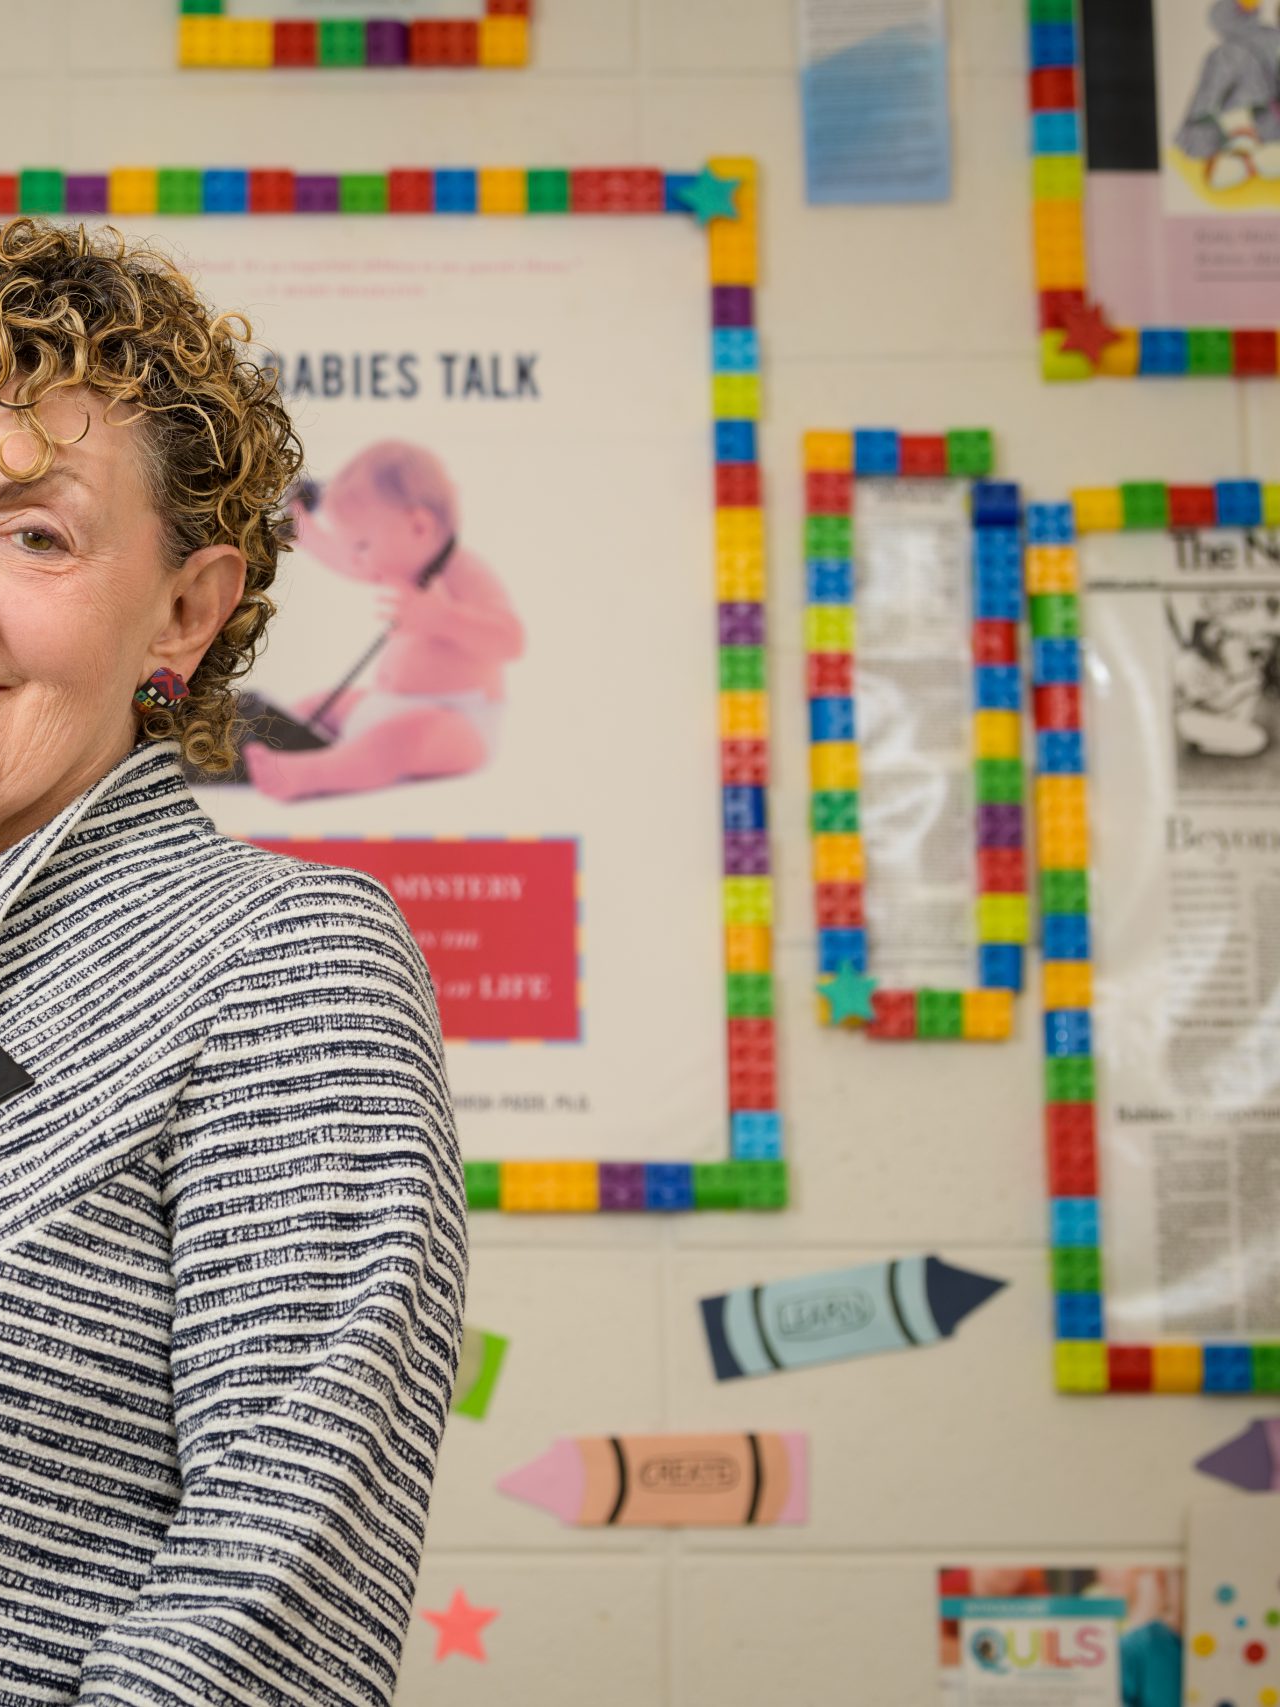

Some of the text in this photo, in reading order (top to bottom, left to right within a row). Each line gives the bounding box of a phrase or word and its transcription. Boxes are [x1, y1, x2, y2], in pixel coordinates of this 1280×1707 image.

[437, 351, 541, 399] TALK
[391, 875, 526, 901] MYSTERY
[478, 974, 549, 1000] LIFE
[780, 1292, 875, 1335] LEARN
[639, 1457, 738, 1489] CREATE
